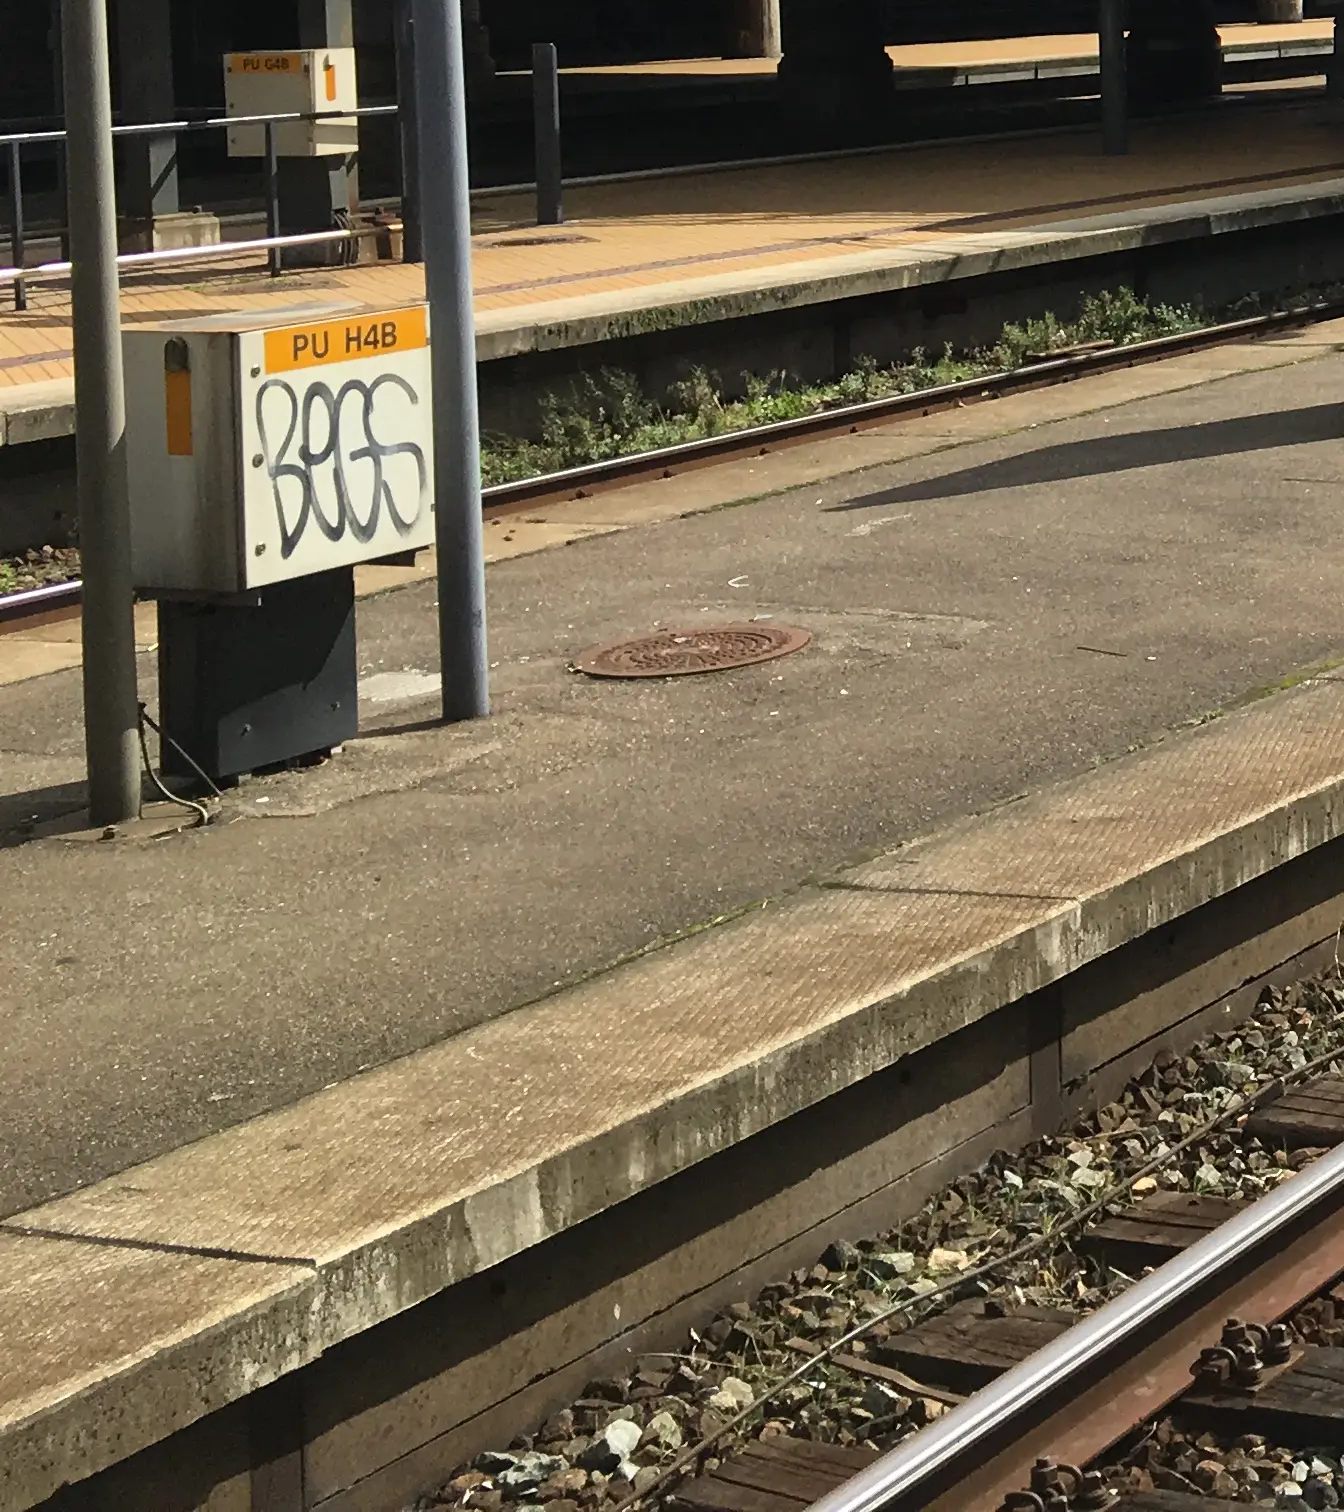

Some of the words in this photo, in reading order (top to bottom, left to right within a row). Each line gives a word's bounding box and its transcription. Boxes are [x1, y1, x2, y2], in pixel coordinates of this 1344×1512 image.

[243, 56, 261, 70] PU
[293, 329, 330, 362] PU
[346, 320, 397, 352] H4B
